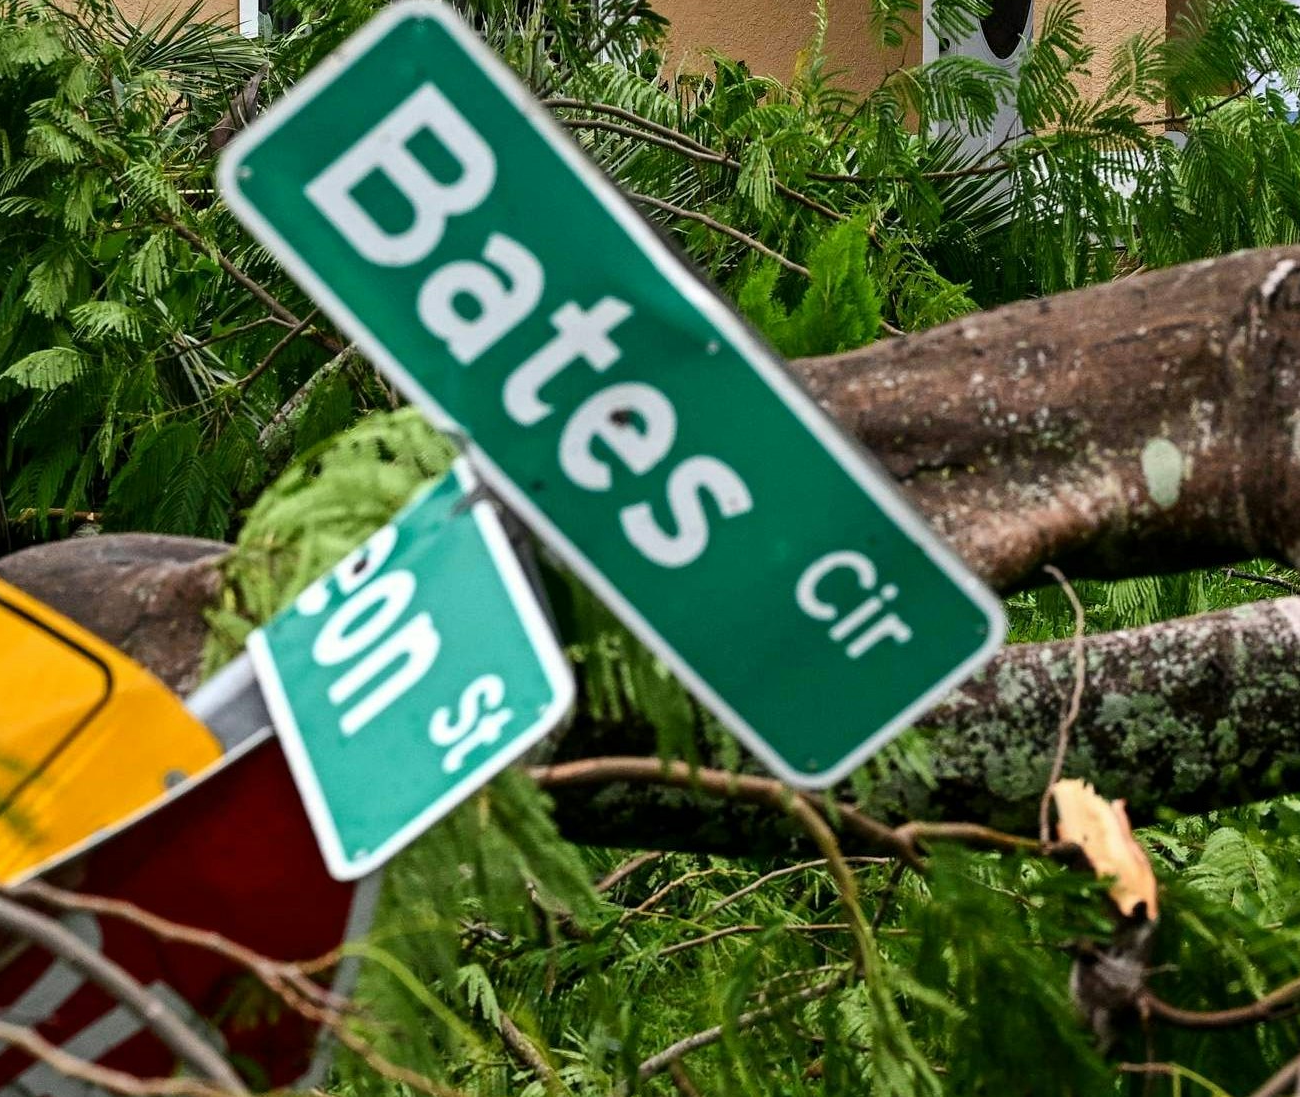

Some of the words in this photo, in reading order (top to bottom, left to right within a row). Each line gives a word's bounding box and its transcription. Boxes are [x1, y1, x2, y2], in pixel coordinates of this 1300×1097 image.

[304, 81, 753, 568] Bates
[795, 549, 913, 659] Cir
[428, 673, 514, 774] St
